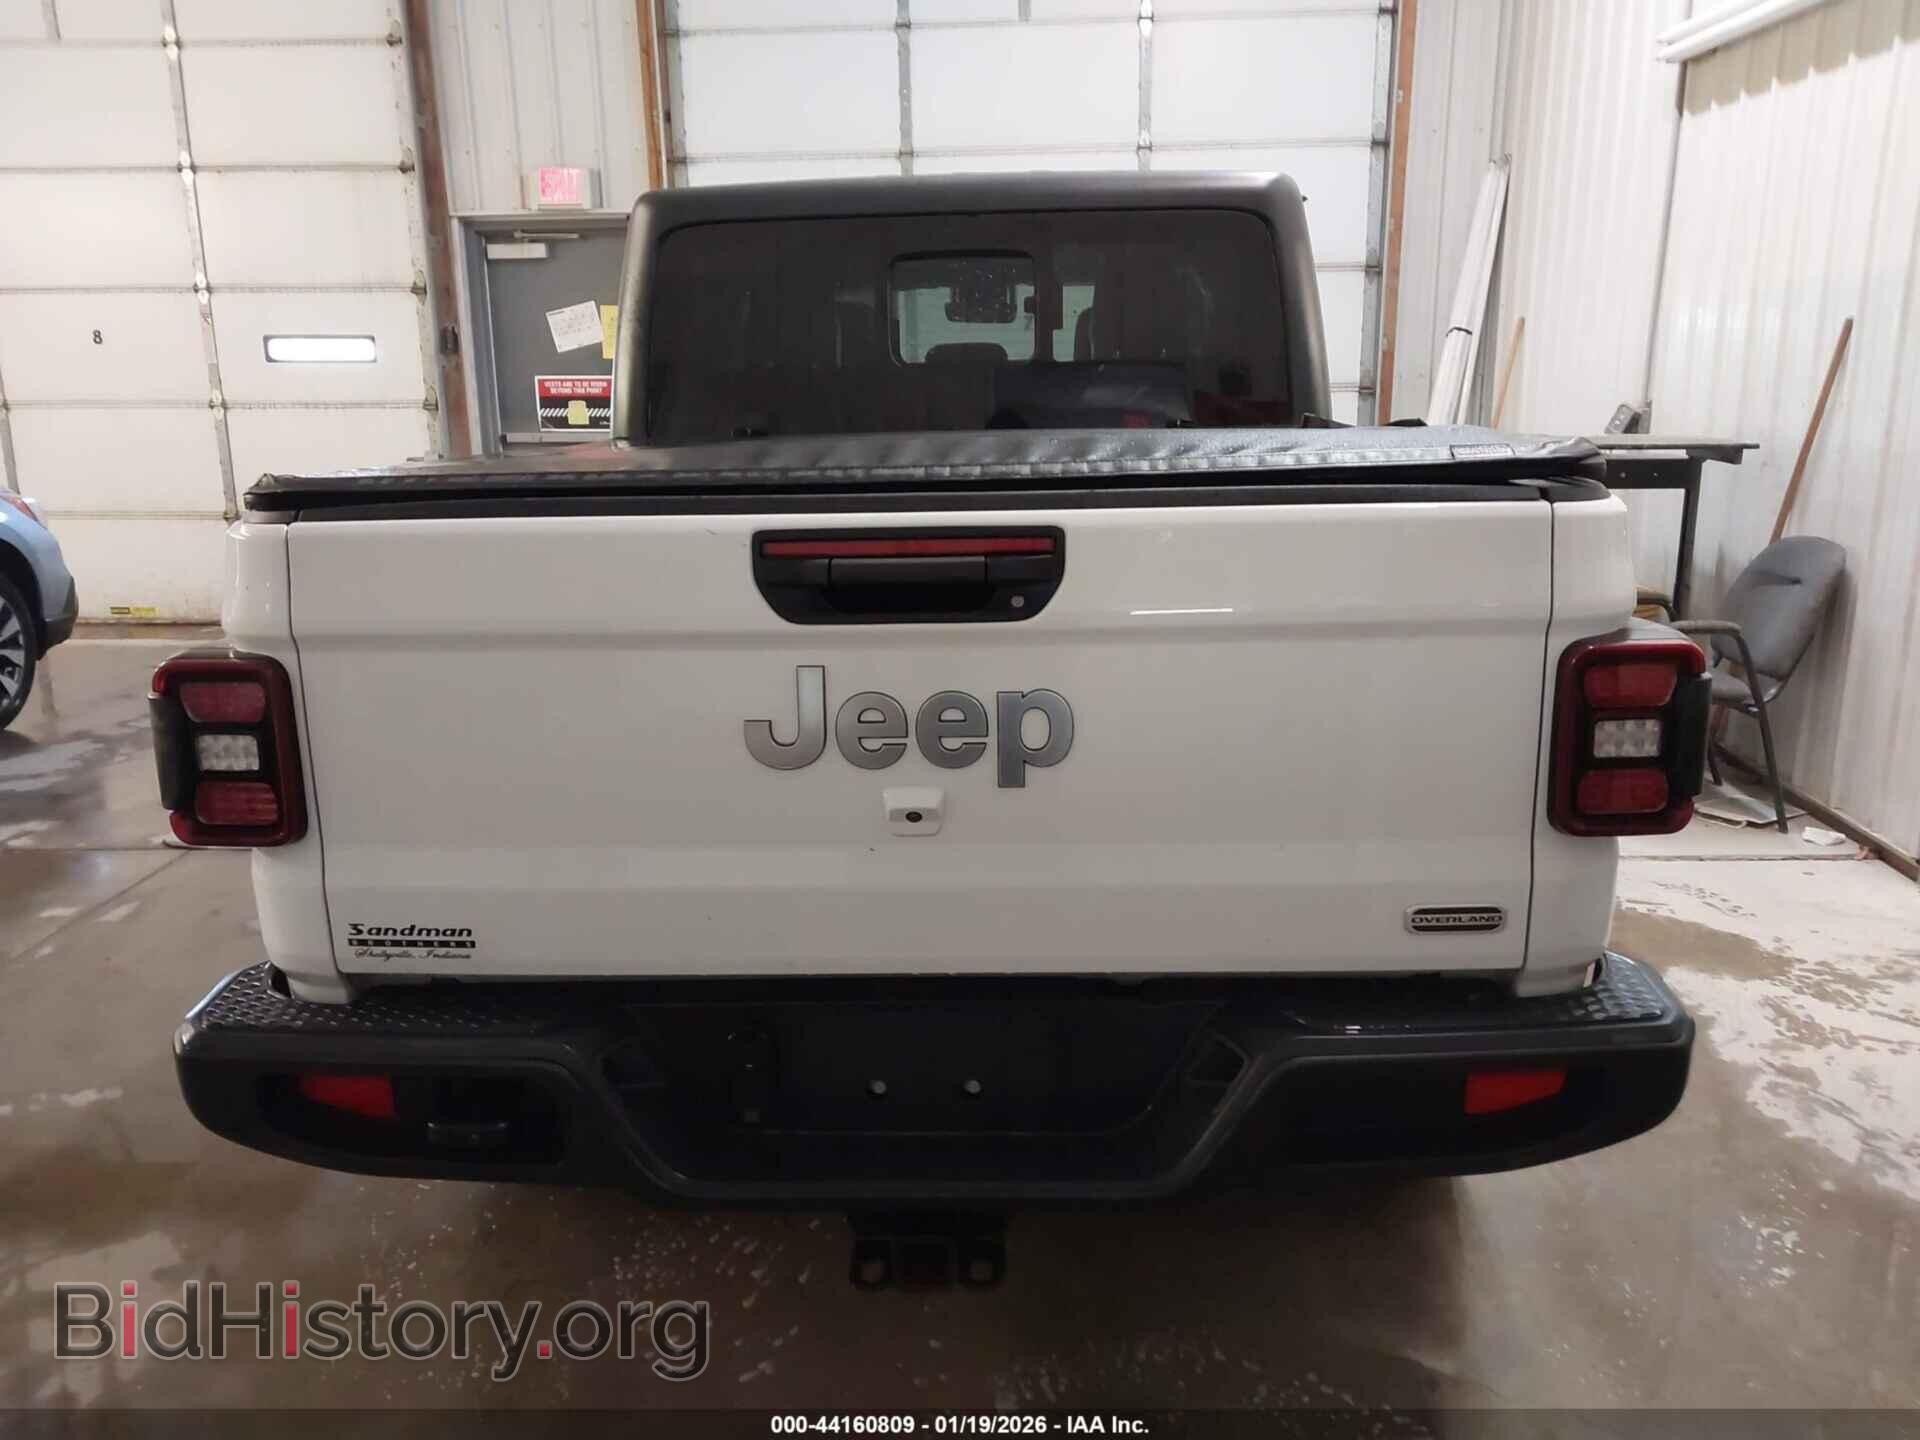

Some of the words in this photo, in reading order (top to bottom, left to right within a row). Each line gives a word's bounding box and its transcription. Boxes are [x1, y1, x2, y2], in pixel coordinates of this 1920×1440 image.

[92, 329, 103, 345] 8
[743, 665, 1075, 788] Jeep
[1411, 915, 1503, 924] OVERLAND
[347, 923, 473, 937] Sandman
[350, 939, 474, 948] BROTHERS
